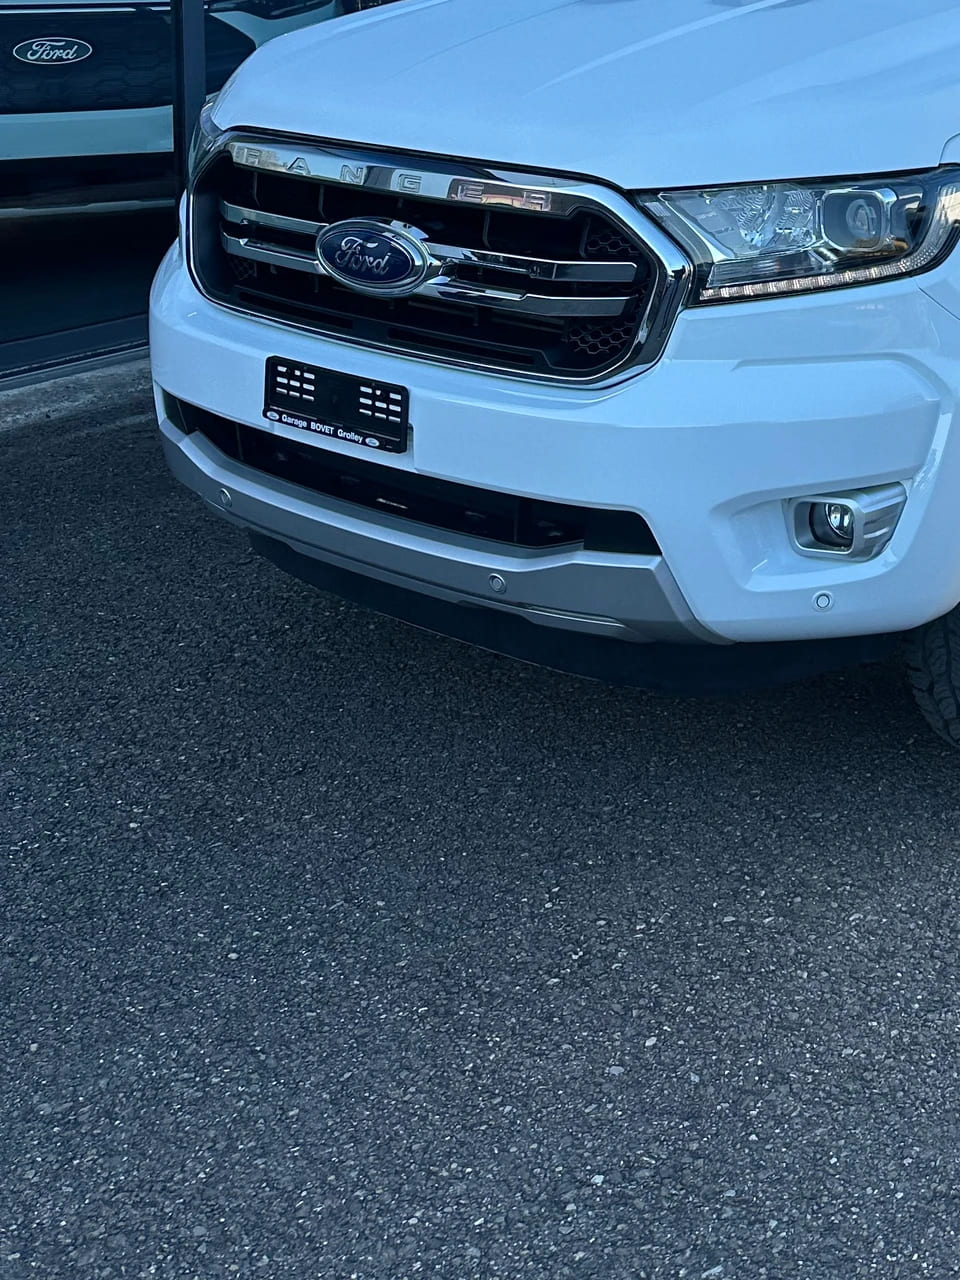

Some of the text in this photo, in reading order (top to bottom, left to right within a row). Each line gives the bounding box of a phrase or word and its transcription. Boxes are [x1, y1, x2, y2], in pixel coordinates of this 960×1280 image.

[27, 40, 79, 60] Ford
[243, 147, 551, 211] RANGER
[335, 236, 393, 276] Ford
[281, 414, 308, 428] Garage
[310, 422, 334, 434] BOVET
[337, 429, 363, 443] Grolley
